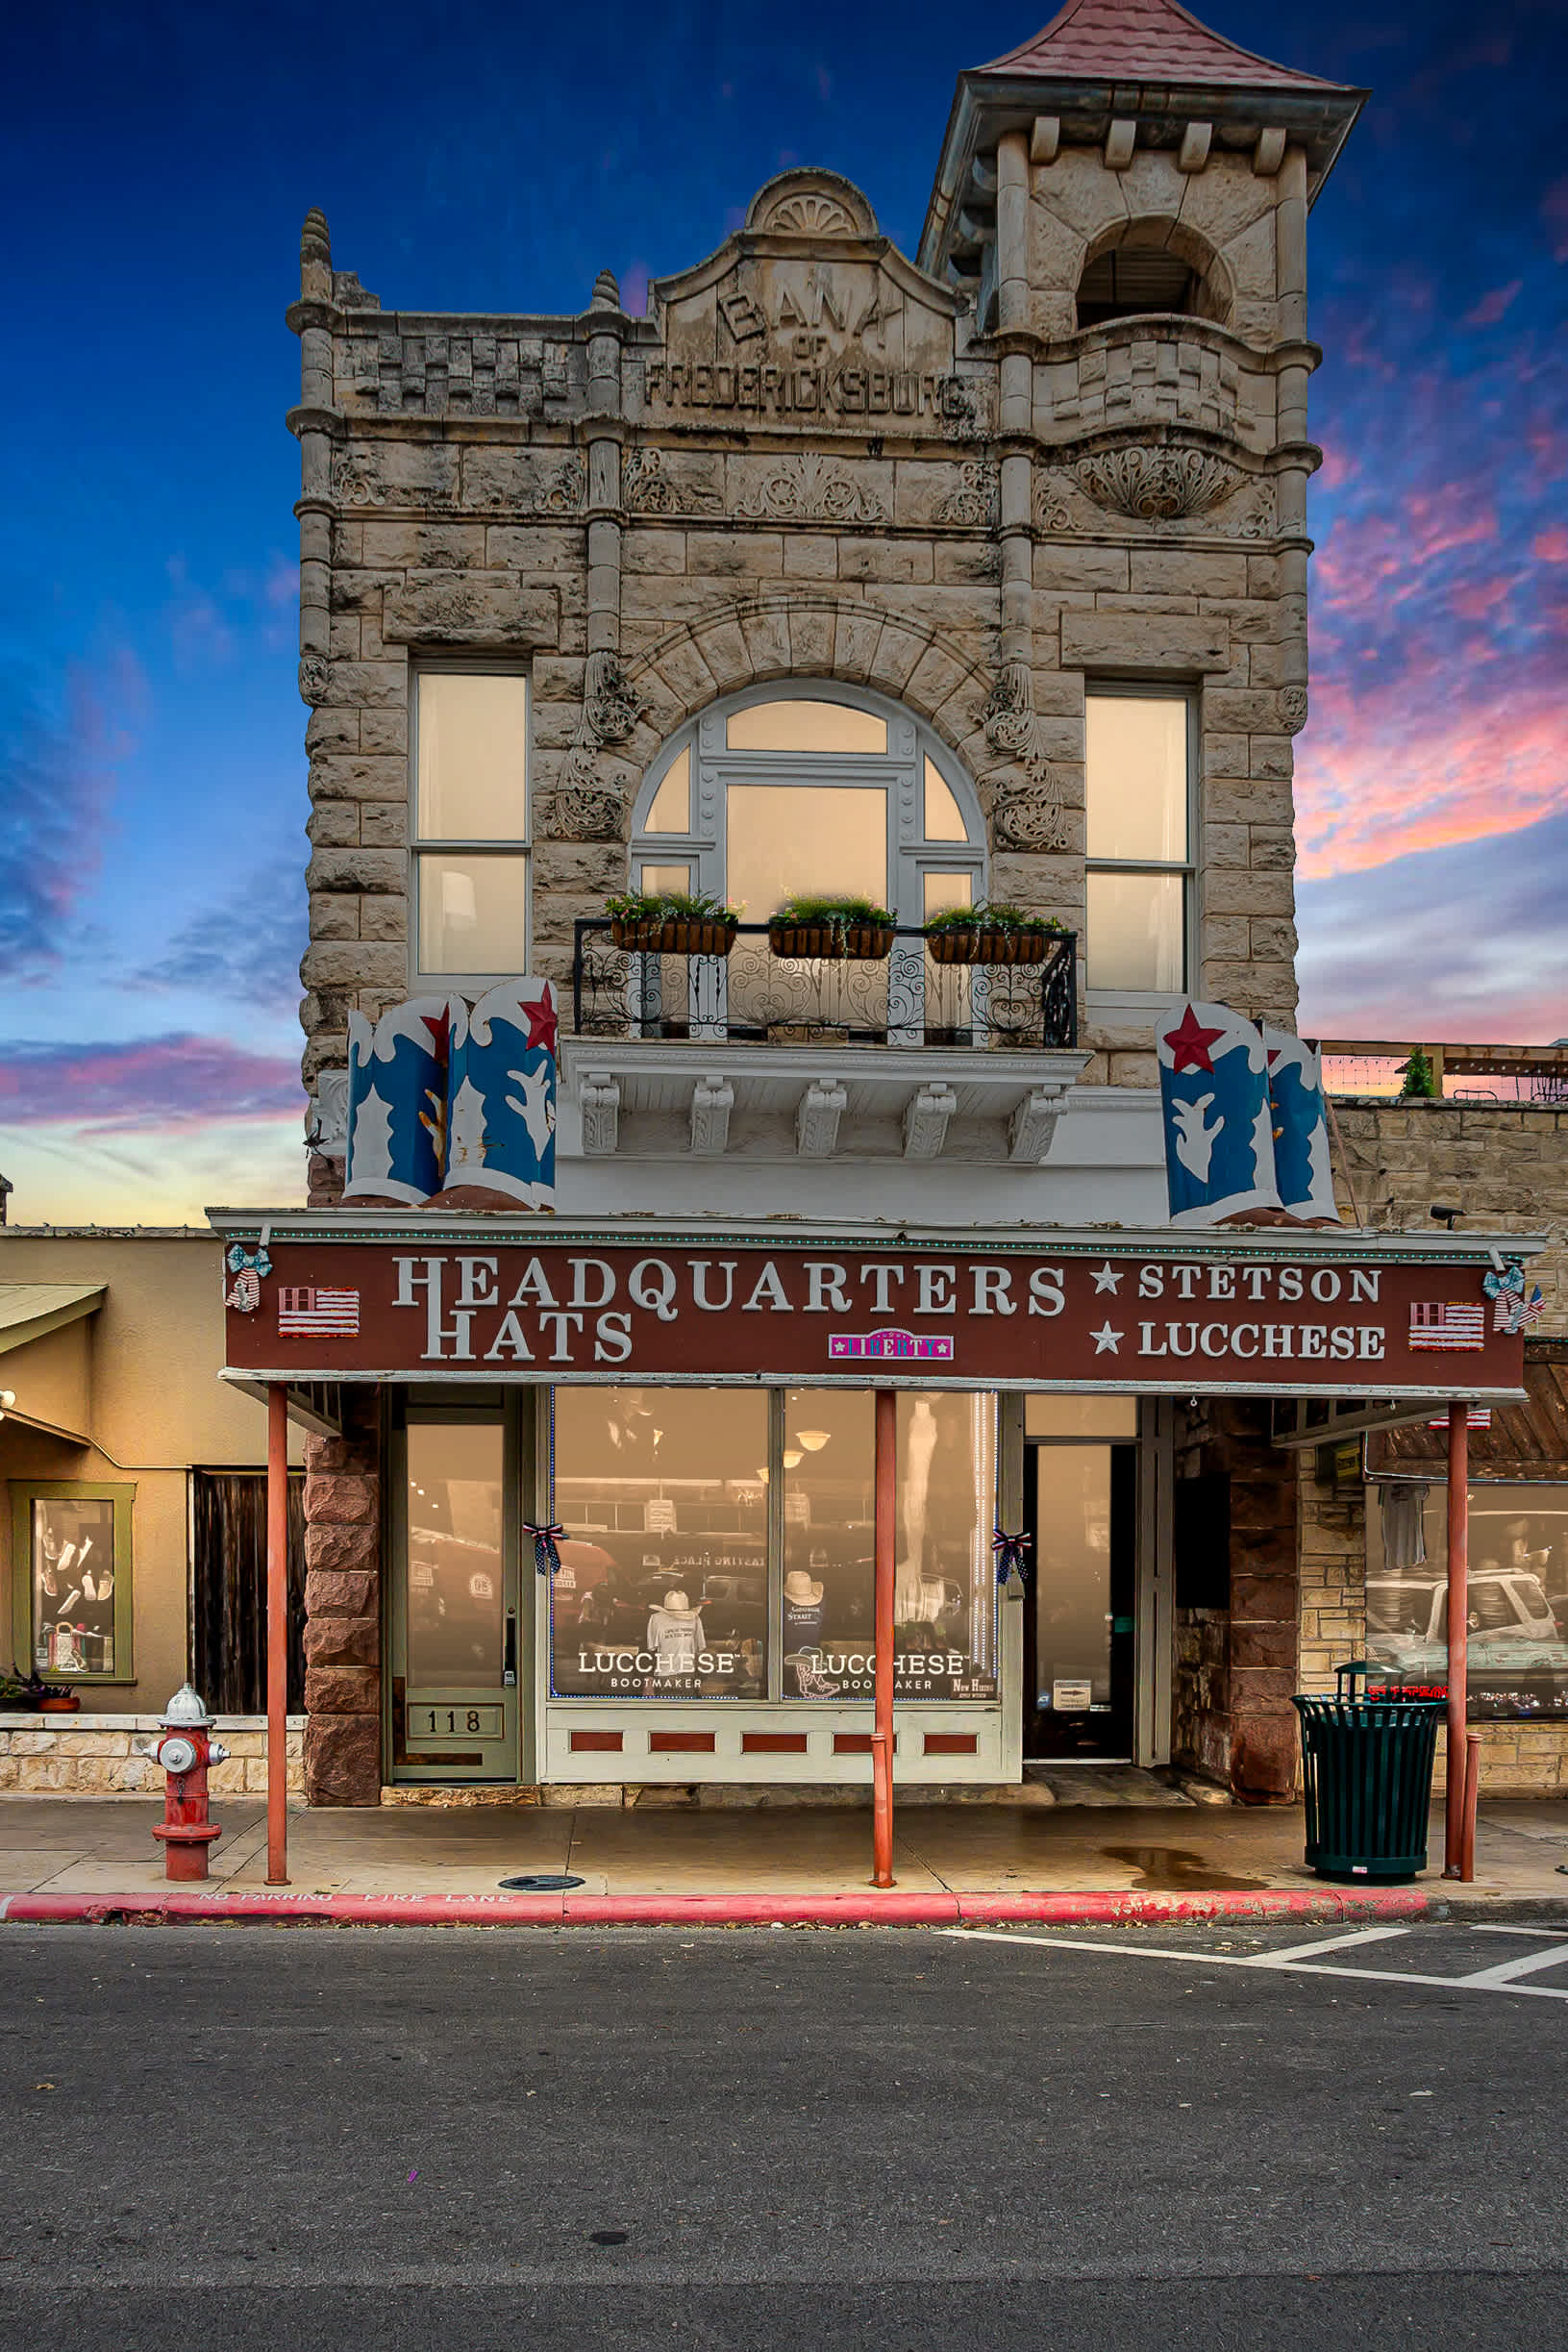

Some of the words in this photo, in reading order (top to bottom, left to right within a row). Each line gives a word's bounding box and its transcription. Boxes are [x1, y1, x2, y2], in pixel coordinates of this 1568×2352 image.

[718, 283, 903, 350] BANK
[791, 335, 828, 361] OF
[645, 359, 977, 420] FREDERICKSBURG
[391, 1256, 1066, 1321] HEADQUARTERS
[1138, 1264, 1382, 1303] STETSON
[420, 1309, 633, 1363] HATS
[848, 1338, 935, 1356] LIBERTY
[1137, 1321, 1385, 1360] LUCCHESE
[578, 1652, 734, 1673] LUCCHESE
[610, 1678, 702, 1689] BOOTMAKER
[842, 1680, 932, 1689] BOOAKER
[428, 1711, 480, 1732] 118
[445, 1894, 514, 1903] LANE
